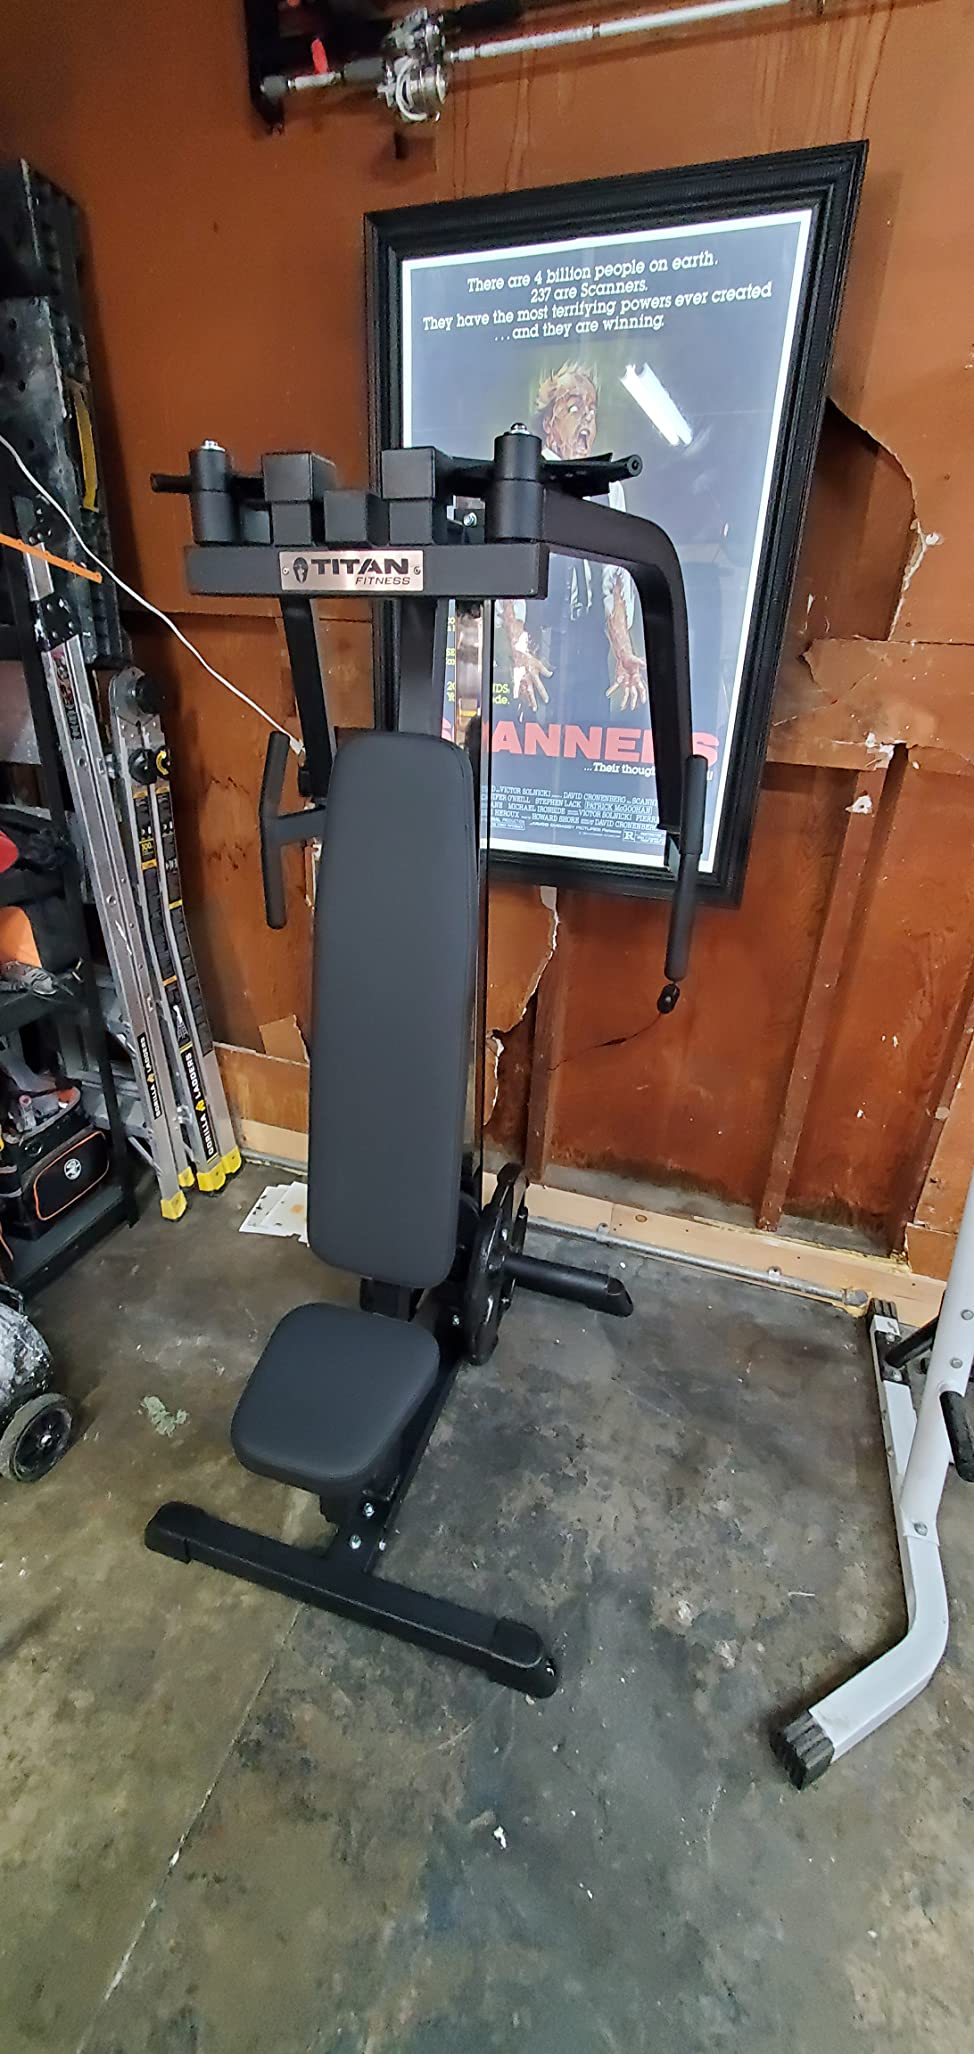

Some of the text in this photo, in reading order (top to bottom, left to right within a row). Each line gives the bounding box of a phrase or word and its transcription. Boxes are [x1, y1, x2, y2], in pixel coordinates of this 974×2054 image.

[467, 250, 718, 292] There are 4 billion people on earth.
[530, 280, 648, 303] 237 are Scanners.
[423, 281, 772, 331] They have the most terrifying powers ever created
[543, 322, 572, 337] they
[575, 320, 599, 333] are
[603, 314, 664, 330] winning.
[311, 558, 409, 574] TITAN
[355, 577, 411, 585] FITNESS
[624, 831, 634, 840] R
[140, 1036, 162, 1118] GORILLA LADDERS
[185, 1052, 214, 1156] GORILLA LADDERS
